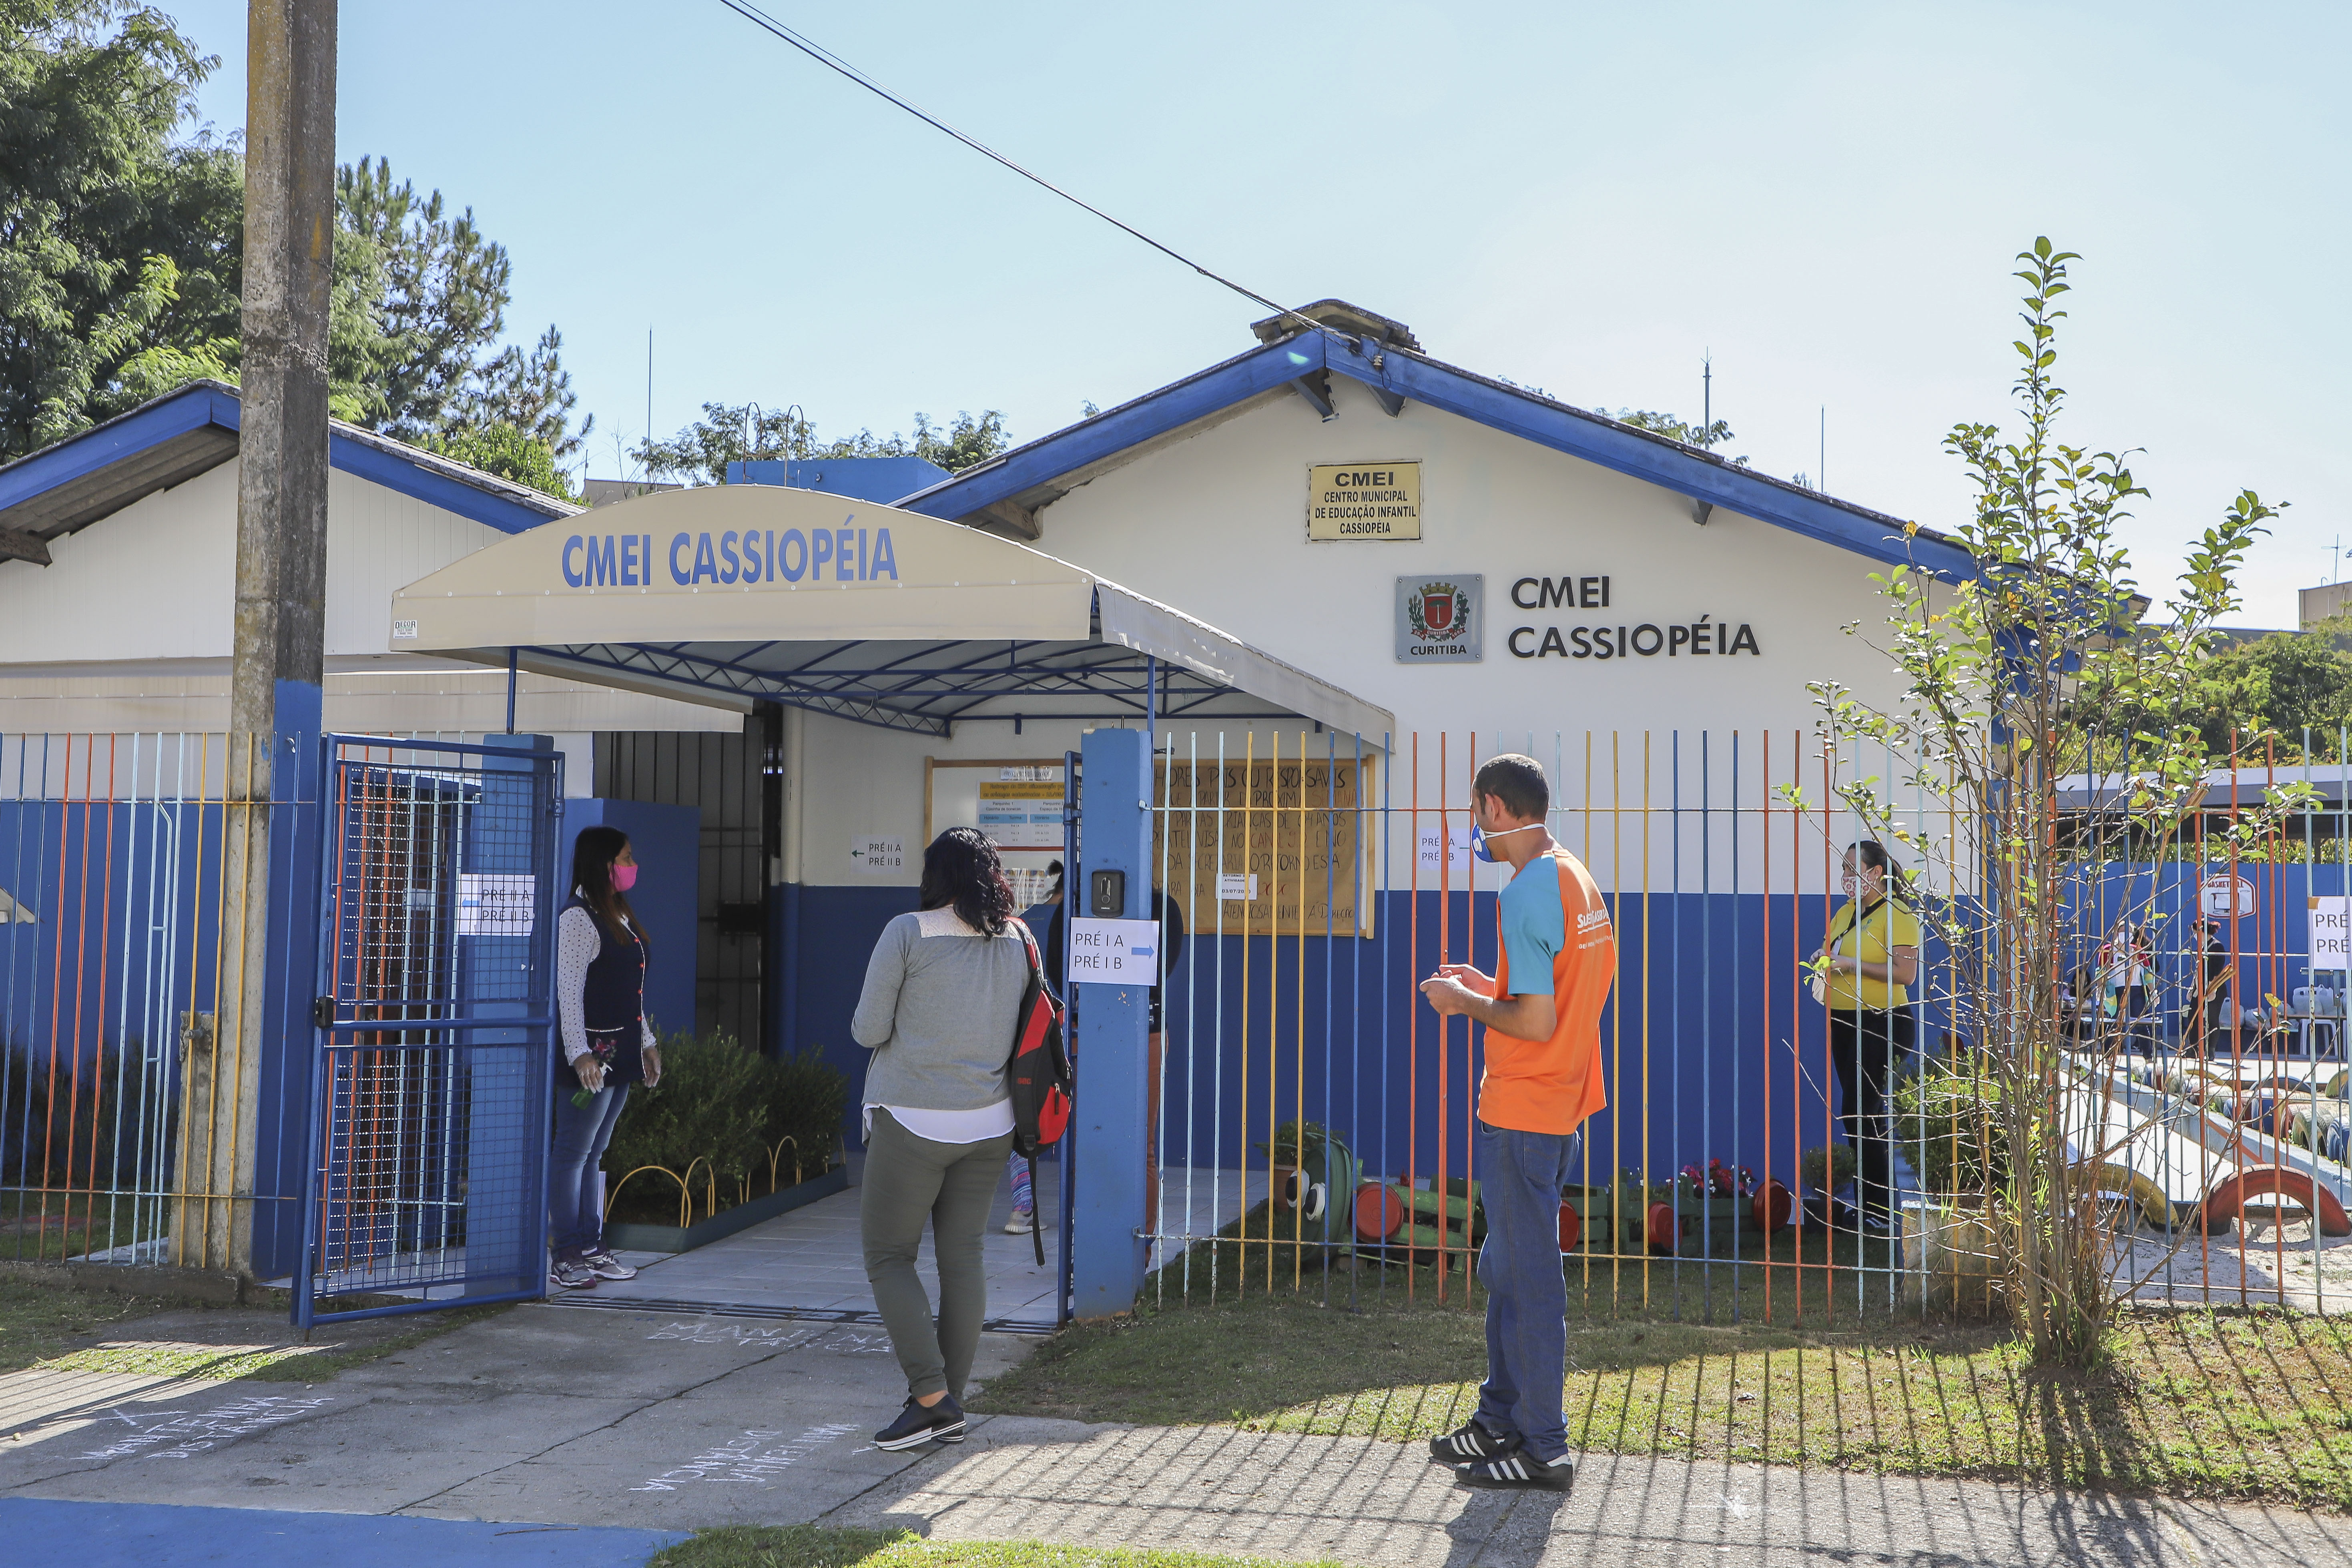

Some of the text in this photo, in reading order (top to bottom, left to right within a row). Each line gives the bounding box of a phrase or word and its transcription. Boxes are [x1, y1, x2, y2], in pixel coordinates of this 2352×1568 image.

[1335, 471, 1394, 487] CMEI
[1324, 490, 1408, 503] CENTRO MUNICIPAL
[1315, 504, 1416, 521] DE EDUCAÇÃO INFANTIL
[1340, 520, 1391, 534] CASSIOPÉIA
[562, 514, 897, 588] CMEI CASSIOPÉIA
[1511, 576, 1609, 609] CMEI
[1508, 614, 1760, 660] CASSIOPÉIA
[1410, 645, 1467, 655] CURITIBA
[1208, 768, 1236, 788] PIS
[869, 842, 901, 852] PRÉ II A
[1232, 832, 1244, 848] NO
[1250, 831, 1284, 848] CANL
[1422, 836, 1455, 846] PRÉ A
[869, 856, 884, 866] PRÉ
[1422, 850, 1454, 861] PRÉ B
[482, 886, 506, 901] PRÉ
[521, 890, 530, 901] A
[1195, 883, 1205, 897] IA
[482, 907, 506, 922] PRÉ
[522, 911, 529, 922] B
[2315, 910, 2349, 928] PRÉ
[1075, 931, 1124, 947] PRÉ I A
[2317, 935, 2350, 953] PRÉ
[1074, 953, 1122, 969] PRÉ I B
